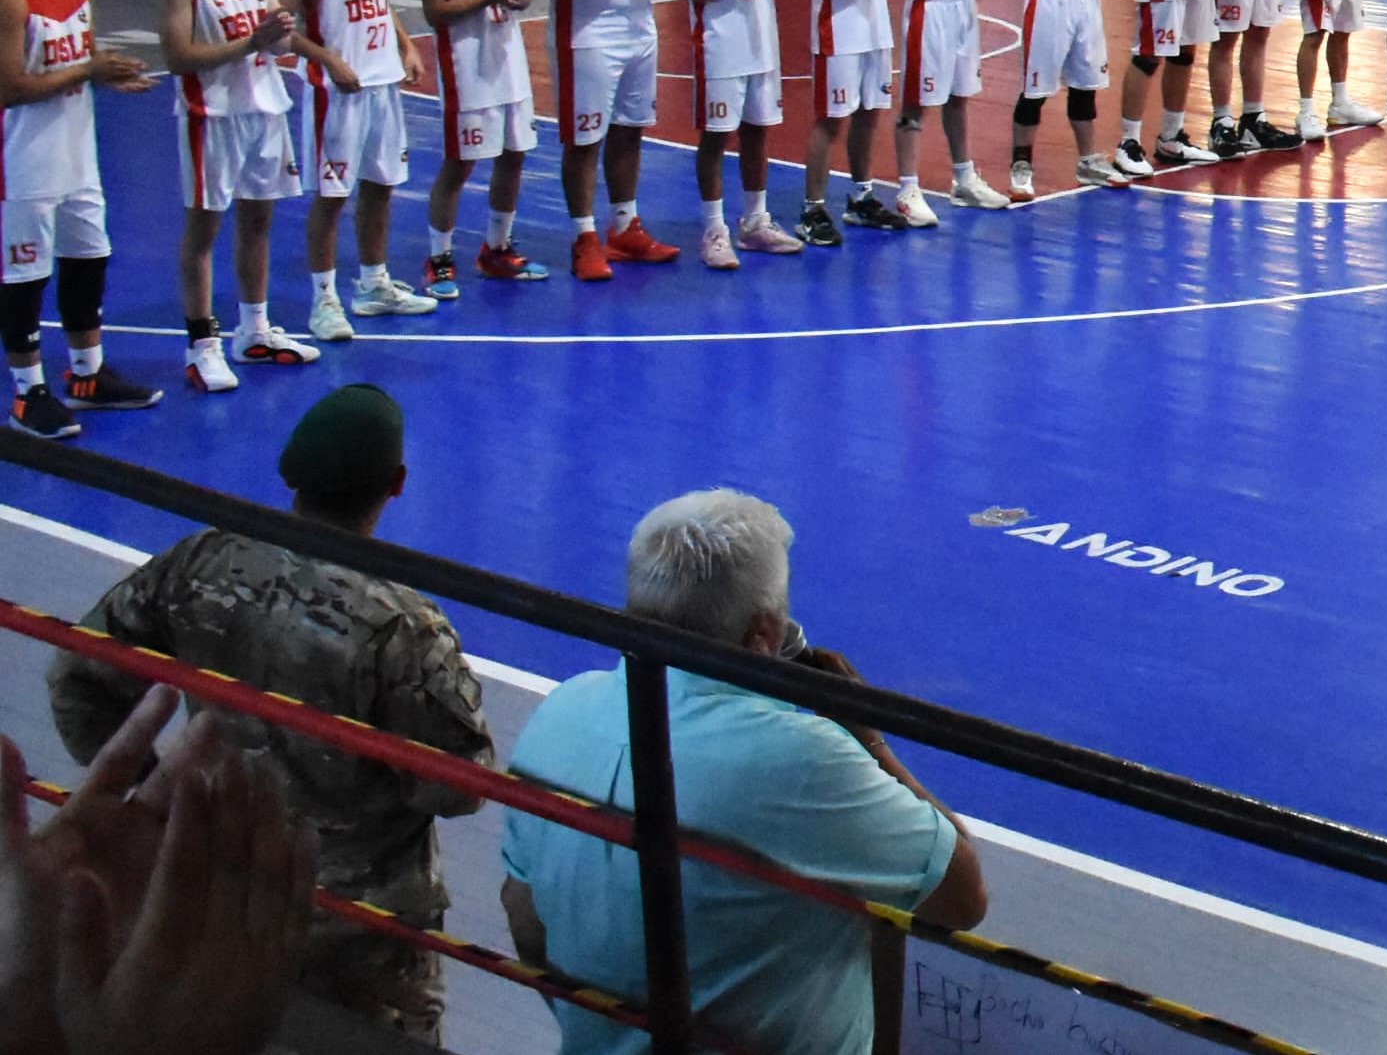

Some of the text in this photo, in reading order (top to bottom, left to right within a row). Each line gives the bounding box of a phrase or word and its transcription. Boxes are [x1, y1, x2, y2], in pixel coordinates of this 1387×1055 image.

[366, 23, 388, 51] 27
[1155, 29, 1176, 45] 24
[924, 77, 935, 93] 5
[1031, 71, 1039, 88] 1
[832, 88, 847, 105] 11
[708, 102, 727, 119] 10
[577, 112, 603, 132] 23
[462, 127, 484, 146] 16
[323, 159, 349, 181] 27
[8, 242, 37, 265] 15
[1003, 521, 1286, 597] ANDINO
